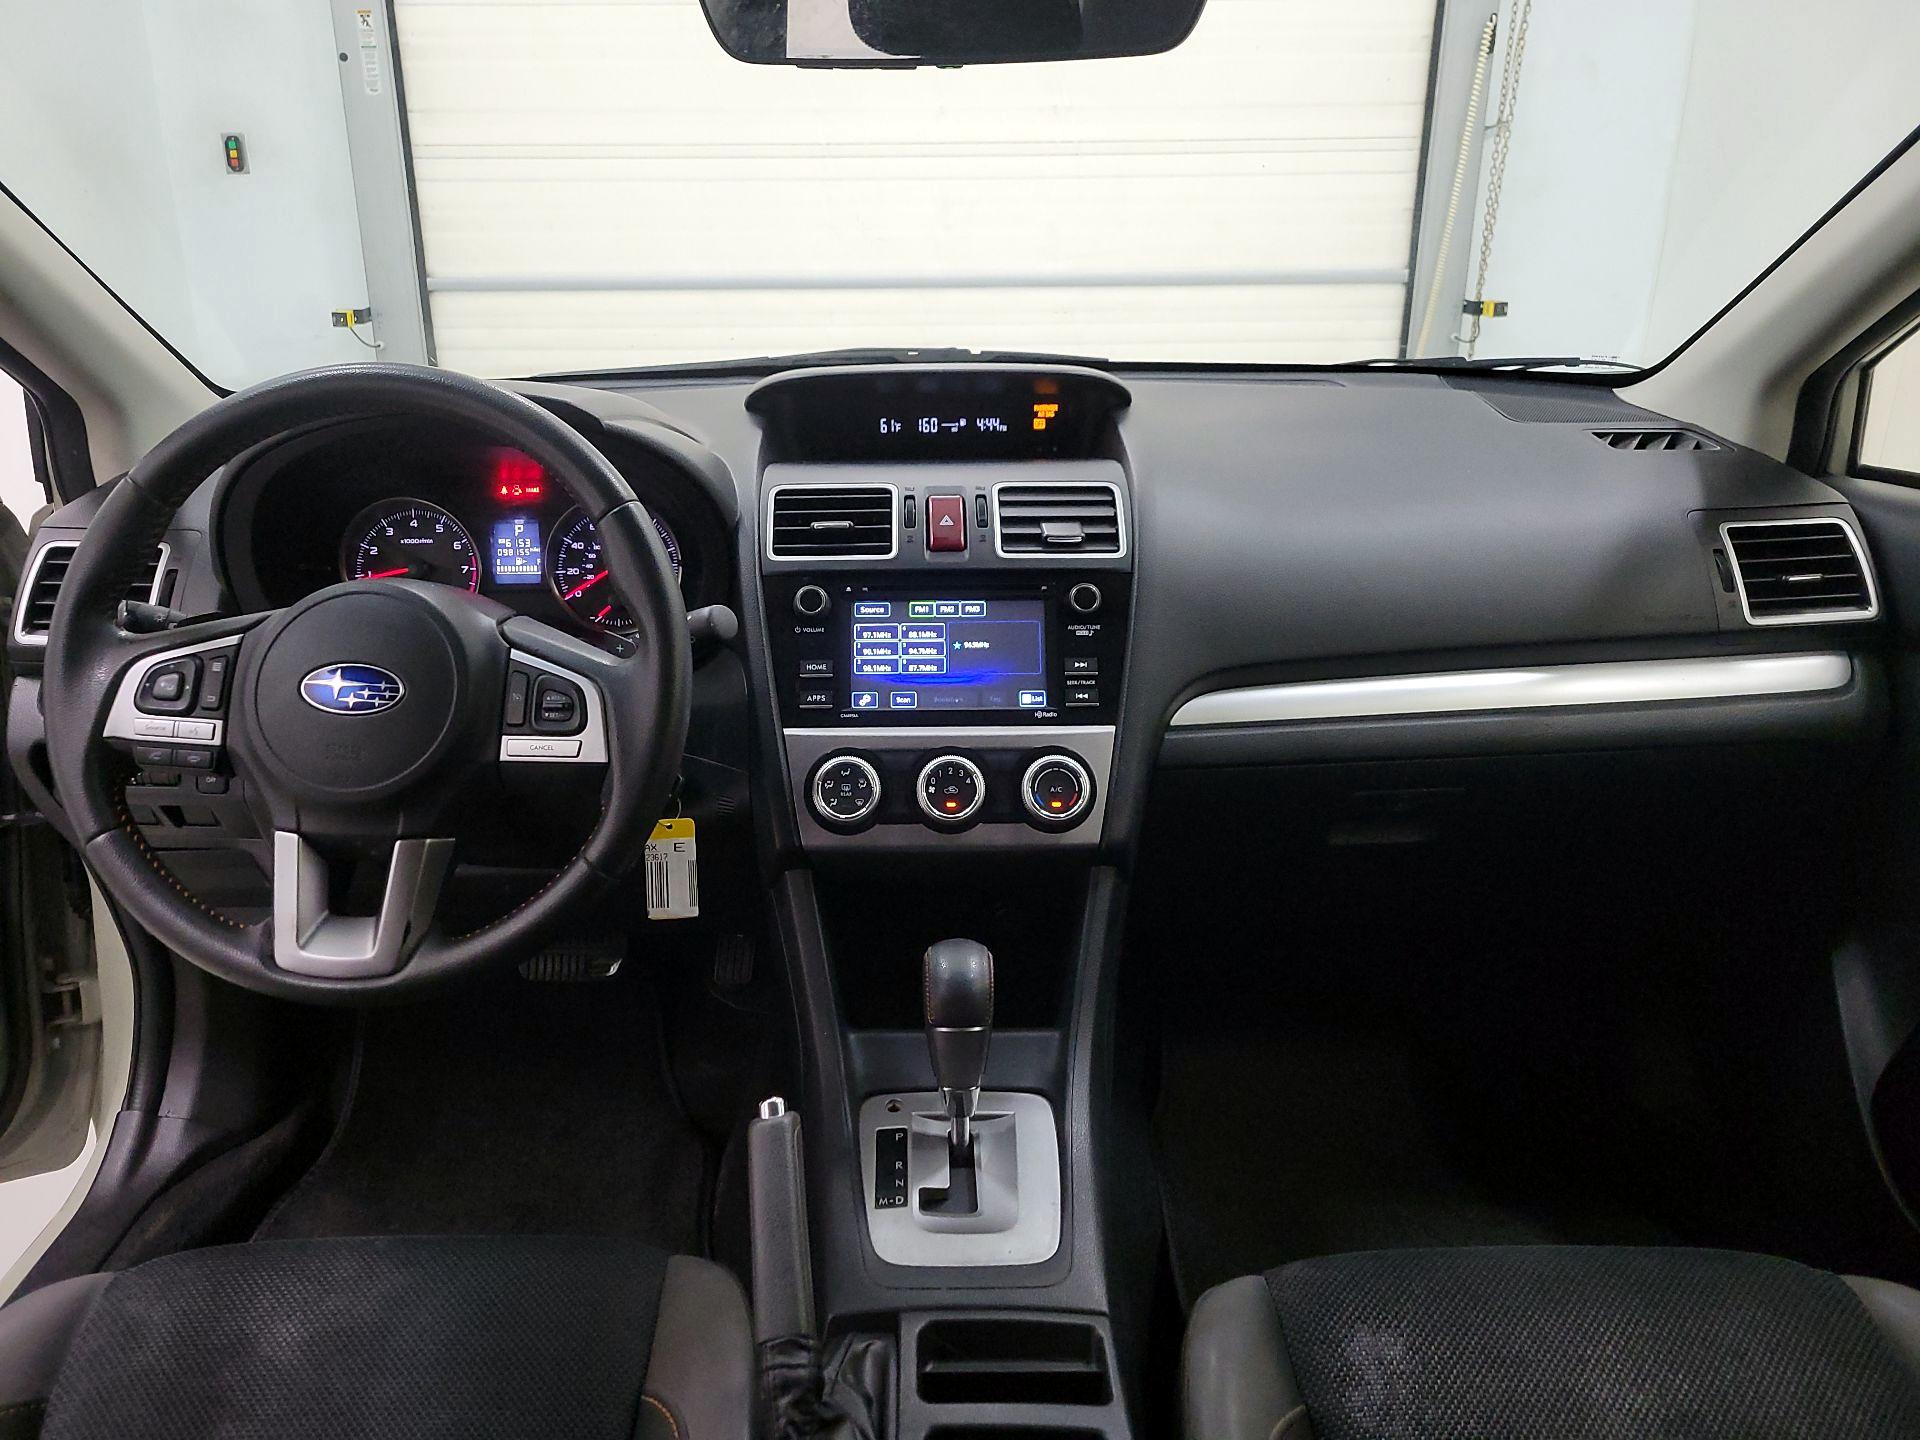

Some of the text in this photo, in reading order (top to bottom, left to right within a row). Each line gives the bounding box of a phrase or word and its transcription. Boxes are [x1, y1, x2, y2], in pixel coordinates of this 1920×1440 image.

[918, 417, 938, 433] 160
[410, 519, 418, 528] 4
[386, 527, 394, 536] 3
[436, 524, 444, 533] 5
[514, 524, 524, 537] P
[453, 541, 462, 550] 6
[571, 542, 584, 550] 40
[370, 546, 378, 555] 2
[460, 565, 469, 574] 7
[575, 590, 582, 598] 0
[938, 770, 942, 778] 1
[948, 767, 953, 775] 2
[959, 769, 964, 777] 3
[674, 842, 685, 852] E
[896, 1133, 904, 1141] P
[896, 1161, 903, 1170] R
[896, 1179, 904, 1187] N
